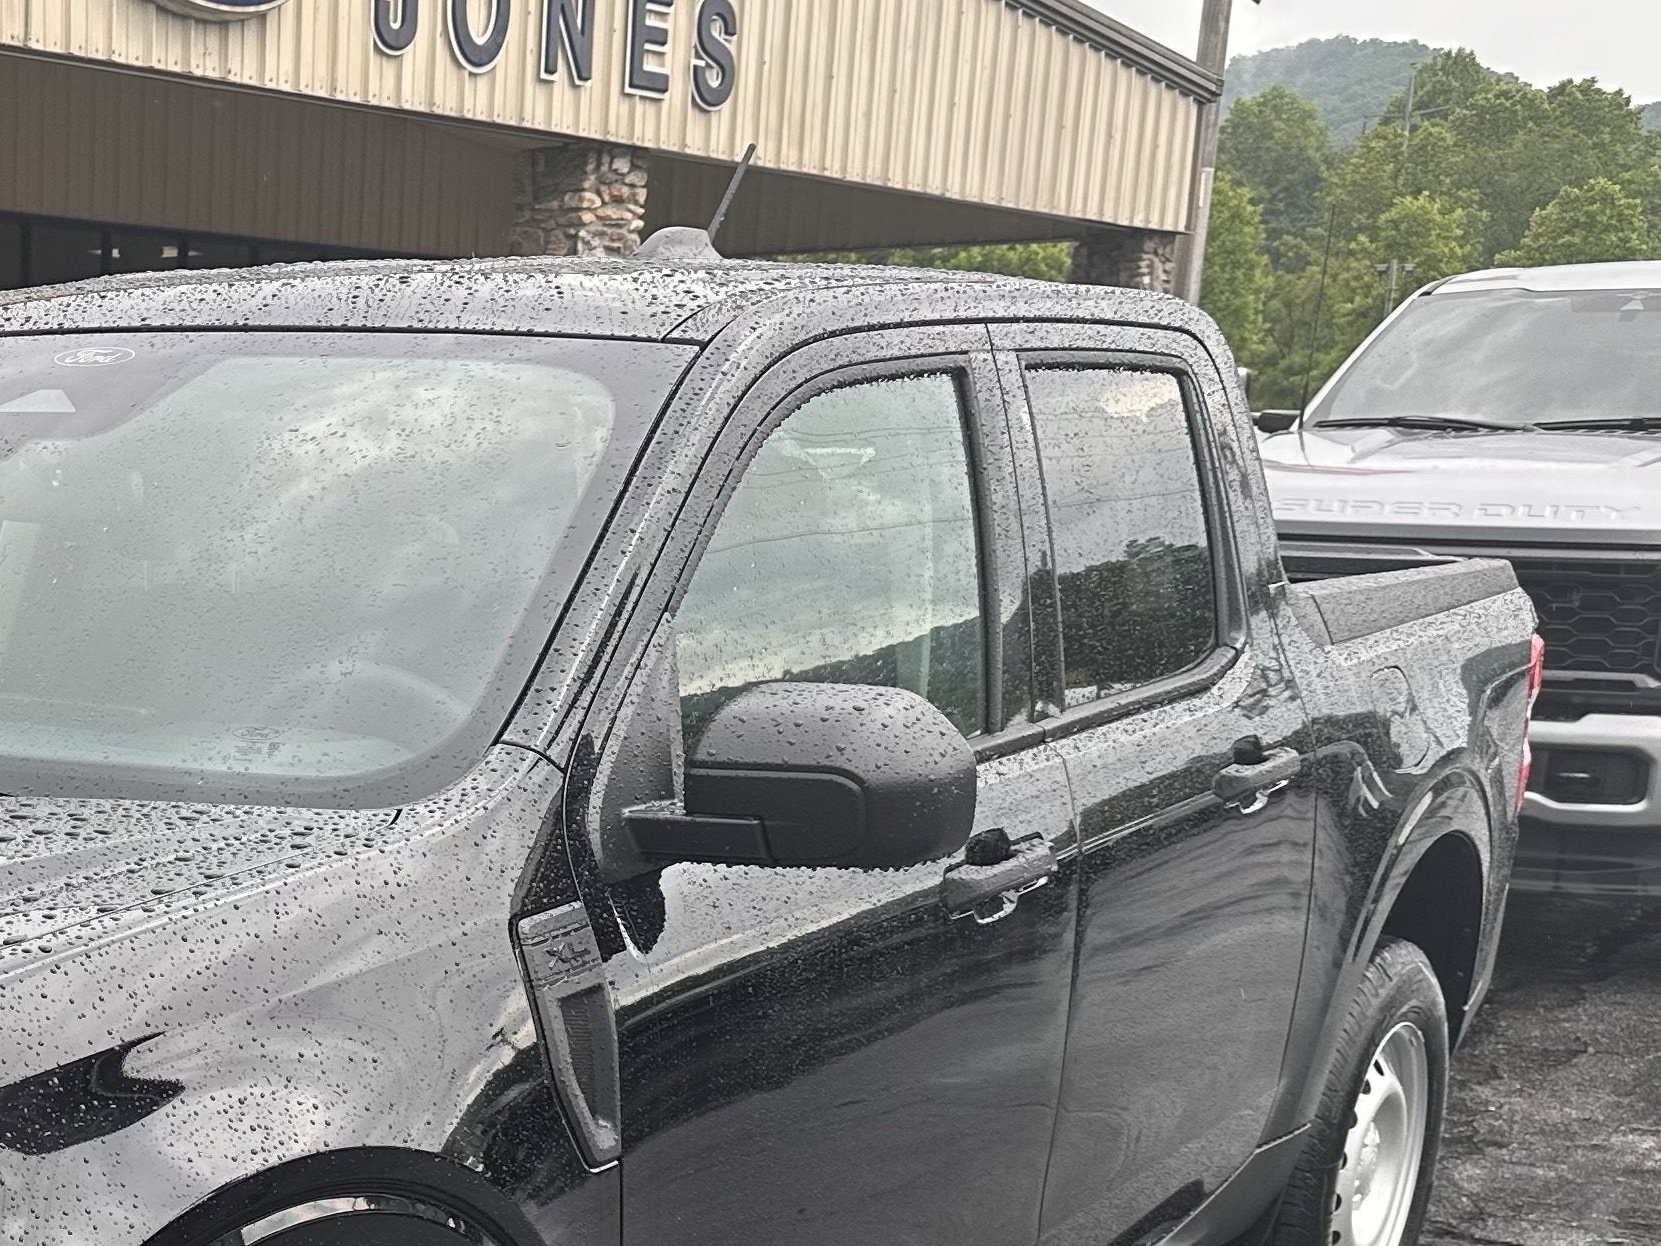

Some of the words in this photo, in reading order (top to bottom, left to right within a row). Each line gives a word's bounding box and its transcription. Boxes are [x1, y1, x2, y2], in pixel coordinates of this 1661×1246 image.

[64, 349, 122, 363] Ford
[1270, 497, 1463, 519] SUPER
[1472, 502, 1641, 521] DUTY
[545, 941, 591, 970] XL
